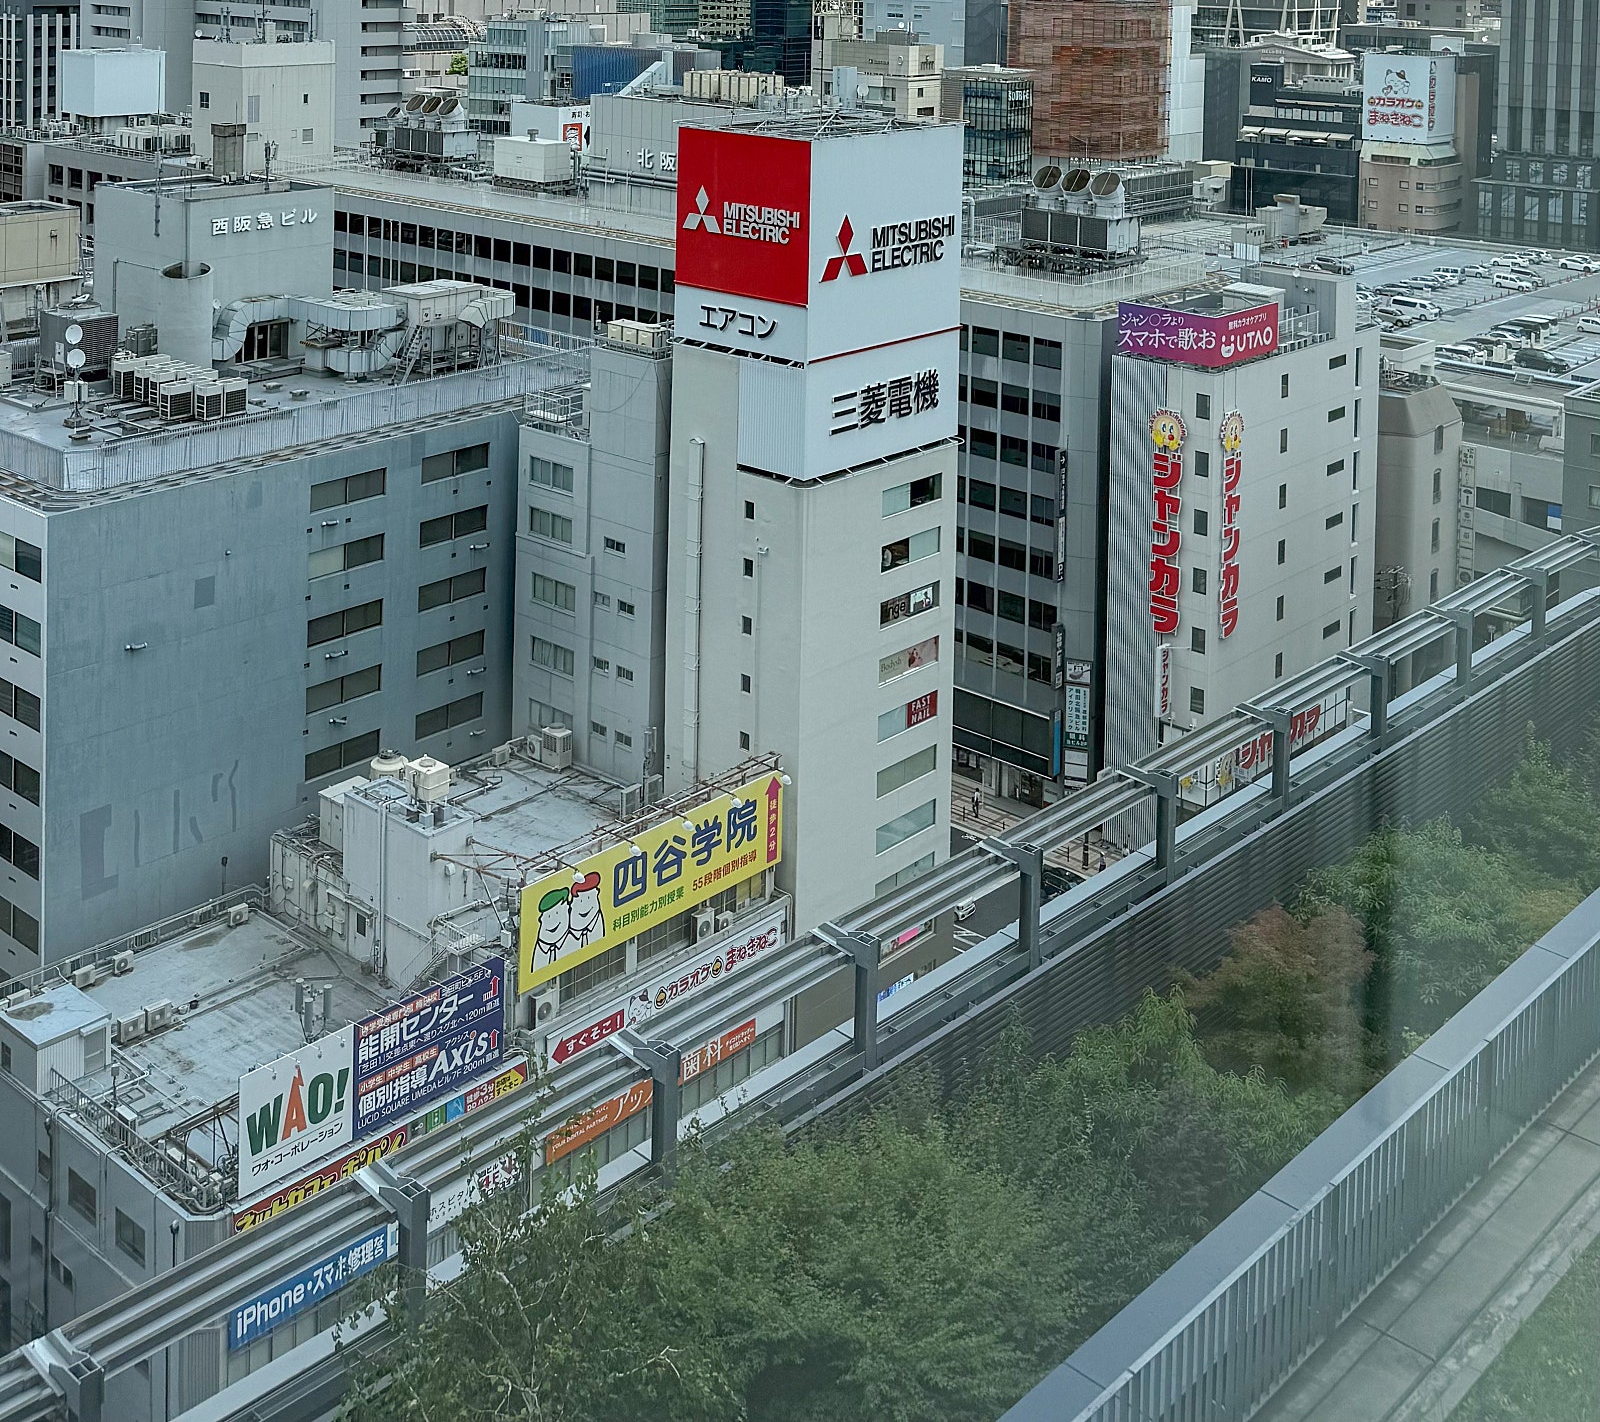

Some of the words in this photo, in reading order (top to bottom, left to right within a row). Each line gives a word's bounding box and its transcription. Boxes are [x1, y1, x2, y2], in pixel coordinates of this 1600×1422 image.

[1367, 108, 1423, 128] まねきねこ
[1374, 97, 1415, 108] カラオケ
[211, 208, 318, 236] 西阪急ビル
[723, 201, 800, 229] MITSUBISHI
[723, 219, 790, 245] ELECTRIC
[871, 215, 955, 249] MITSUBISHI
[871, 240, 944, 273] ELECTRIC
[699, 305, 778, 339] エアコン
[1117, 327, 1216, 350] スマホで歌お
[829, 369, 939, 436] 三菱電機
[1149, 451, 1183, 634] ジャンカラ
[1220, 450, 1242, 640] ジャンカラ
[1161, 648, 1169, 714] ジャンカラ
[911, 708, 931, 725] NAIL
[912, 695, 931, 712] FAST
[769, 798, 778, 851] 徒歩2分
[613, 798, 758, 908] 四谷学院
[692, 849, 757, 892] 55段階個別指導
[612, 886, 685, 932] 科目別能力別授業
[667, 964, 711, 1003] カラオケ
[724, 926, 778, 974] まねきねこ
[359, 994, 474, 1064] 能開センター
[358, 1064, 428, 1118] 個別指導
[361, 1075, 383, 1093] 小学生
[388, 1061, 410, 1078] 中学生
[246, 1066, 350, 1156] WAO!
[357, 1112, 380, 1130] LUCID
[381, 1095, 410, 1118] SQUARE
[252, 1122, 344, 1176] ワオ・コーポレーション
